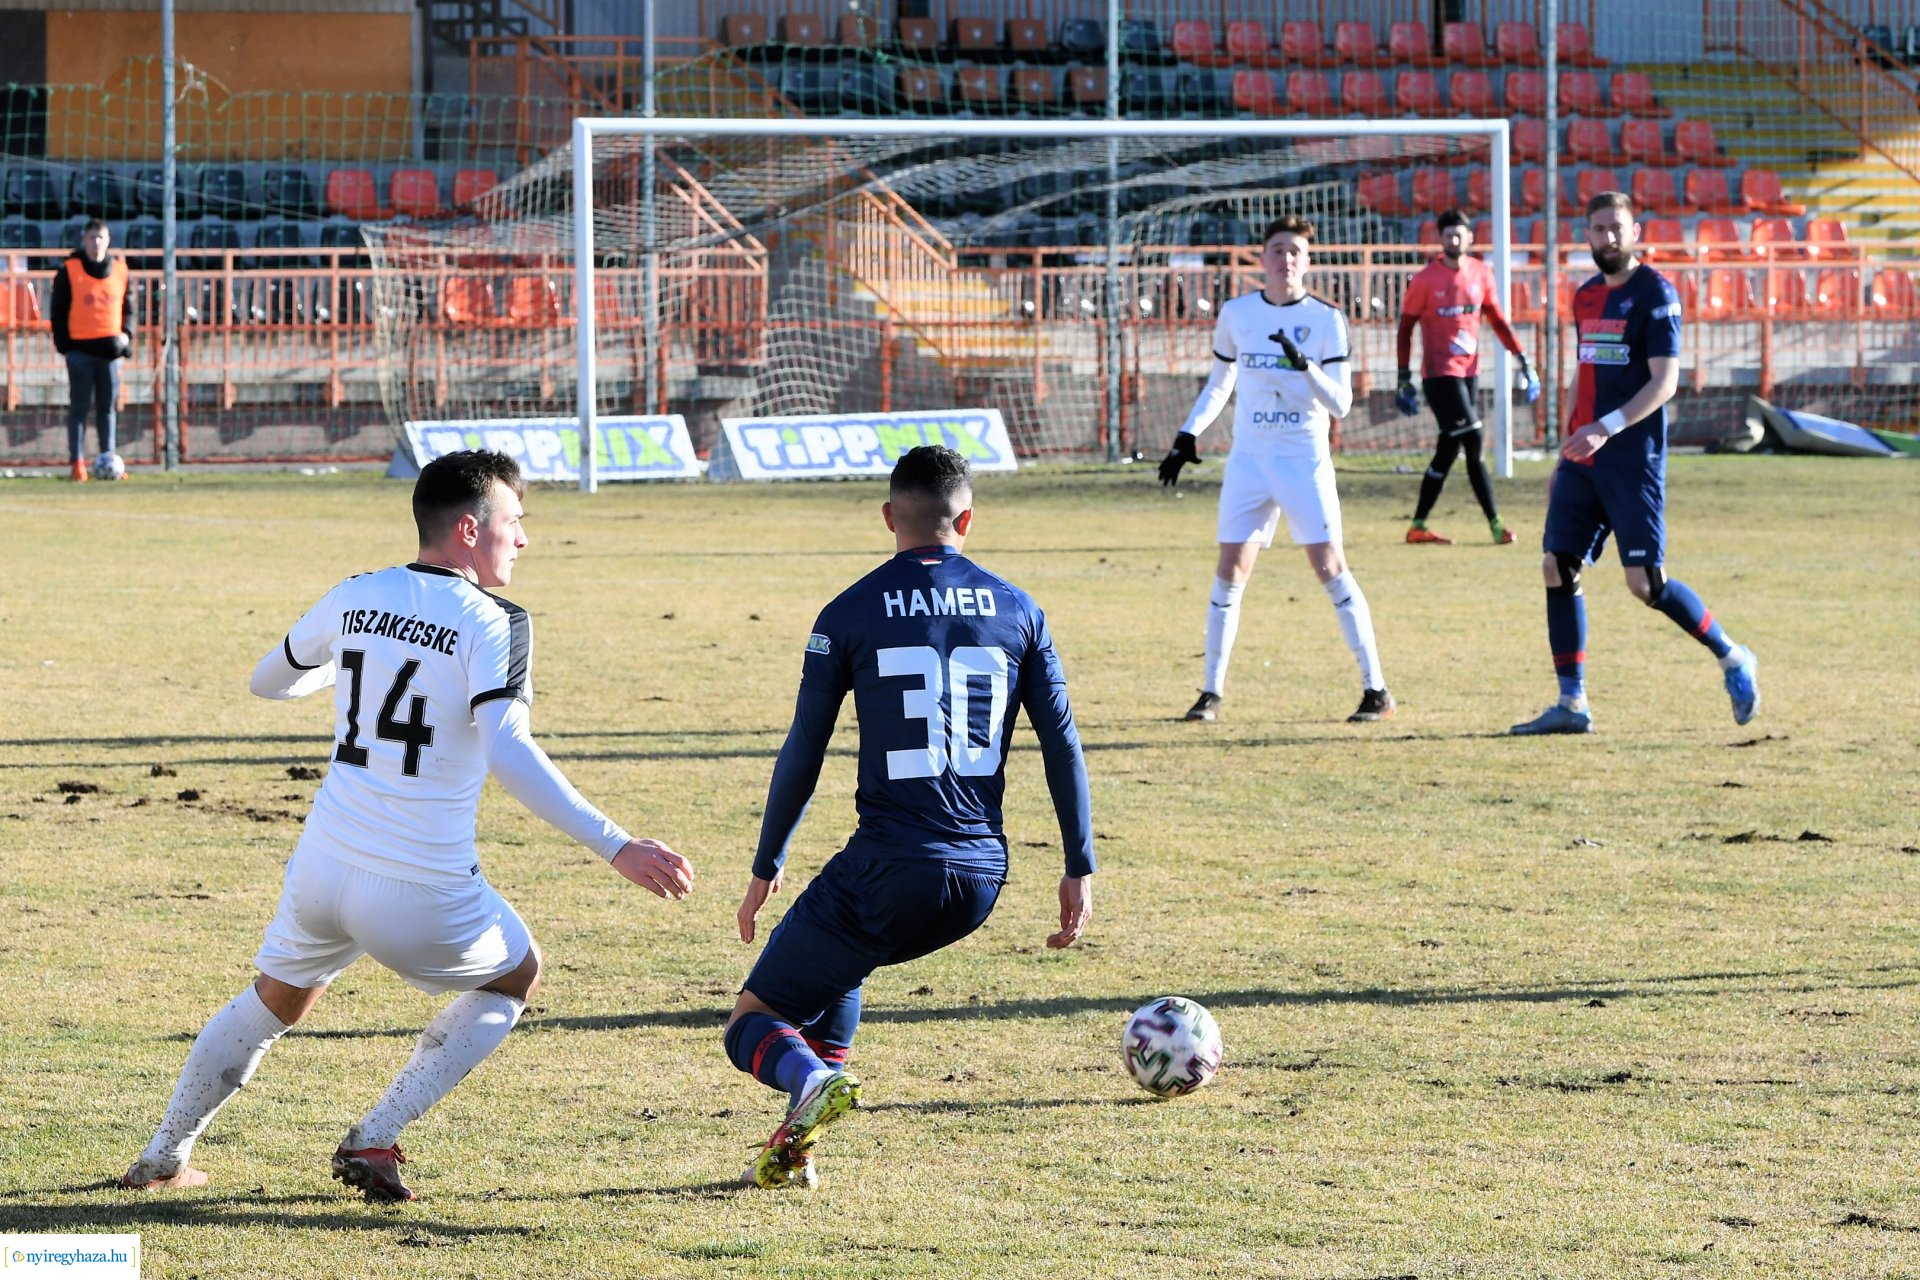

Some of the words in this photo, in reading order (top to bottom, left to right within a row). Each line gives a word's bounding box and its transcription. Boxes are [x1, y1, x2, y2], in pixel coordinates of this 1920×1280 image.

[341, 609, 459, 656] TISZAKÉCSKE
[883, 587, 997, 618] HAMED
[333, 648, 435, 778] 14
[876, 645, 1009, 780] 30
